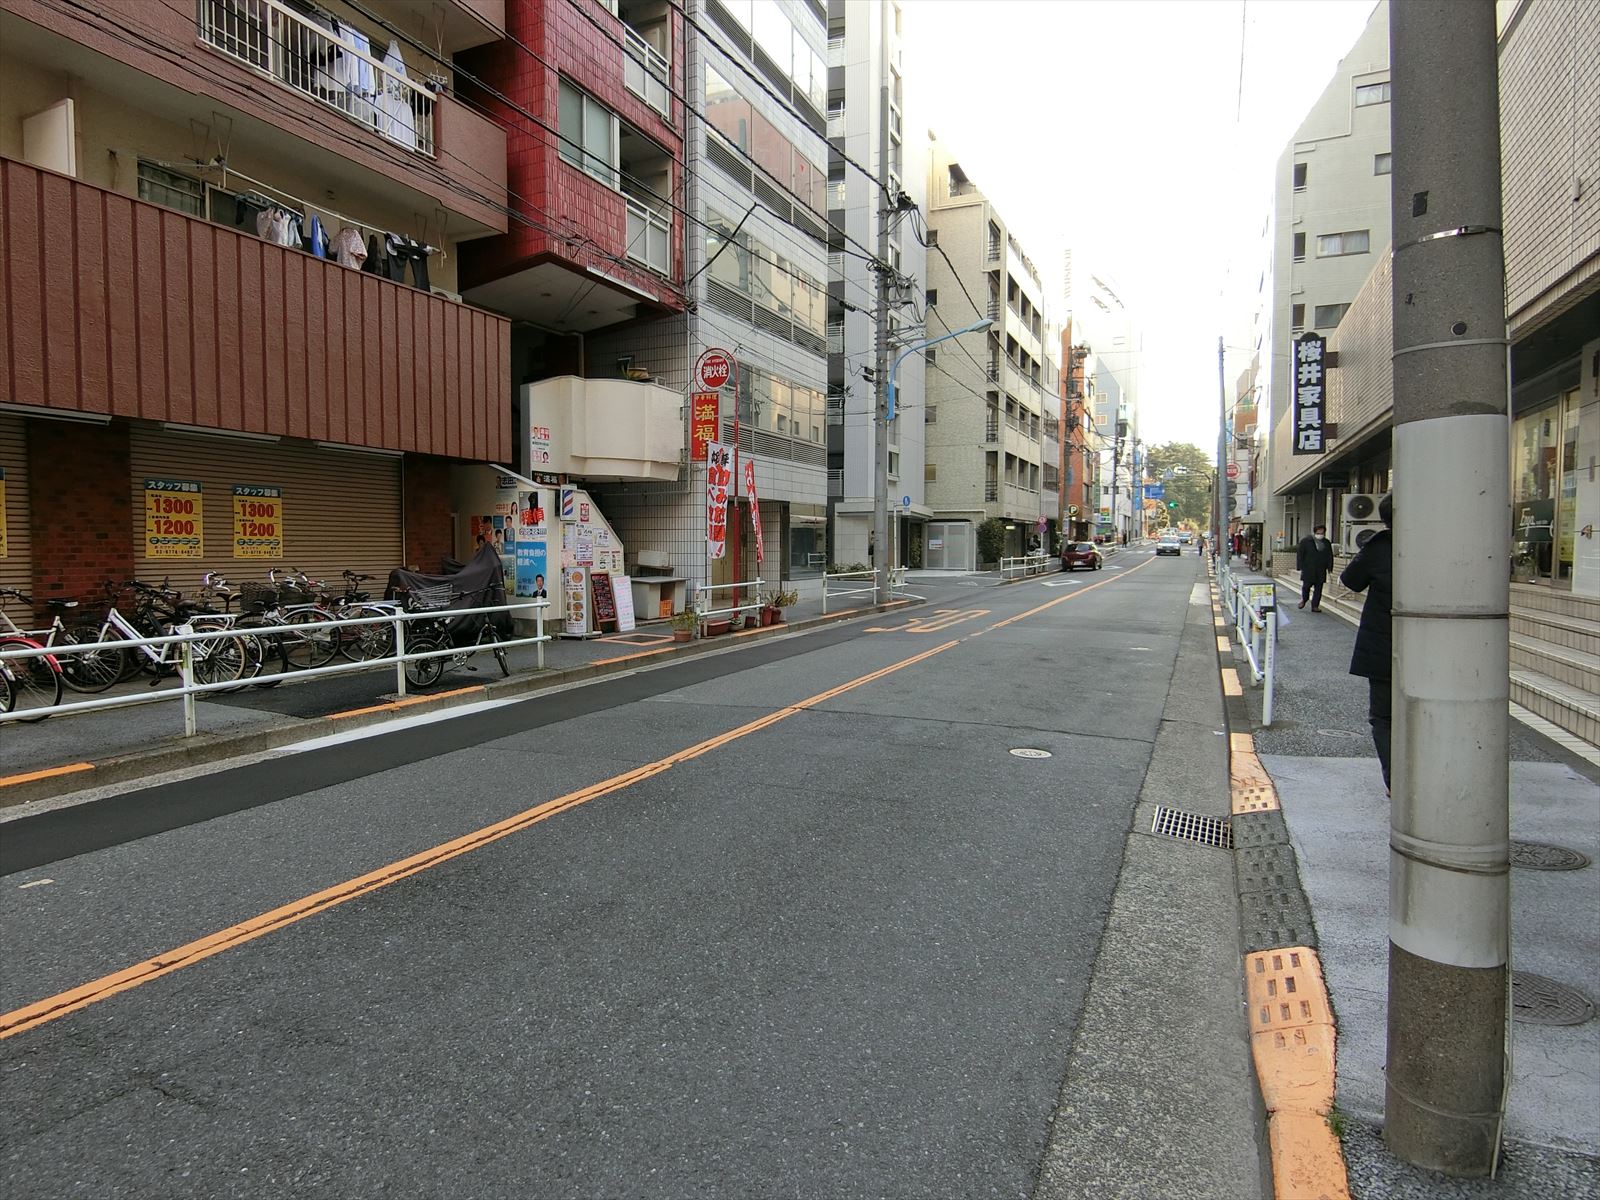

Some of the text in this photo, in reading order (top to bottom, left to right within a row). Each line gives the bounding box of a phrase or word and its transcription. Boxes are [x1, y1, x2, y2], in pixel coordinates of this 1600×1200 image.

[703, 364, 728, 379] 消火栓
[1298, 340, 1322, 450] 桜井家具店
[694, 404, 716, 441] 満福
[148, 481, 198, 491] スタッフ募集
[235, 487, 279, 496] スタッフ募集
[154, 498, 194, 514] 1300
[241, 503, 275, 518] 1300
[154, 519, 194, 535] 1200
[240, 522, 275, 537] 1200
